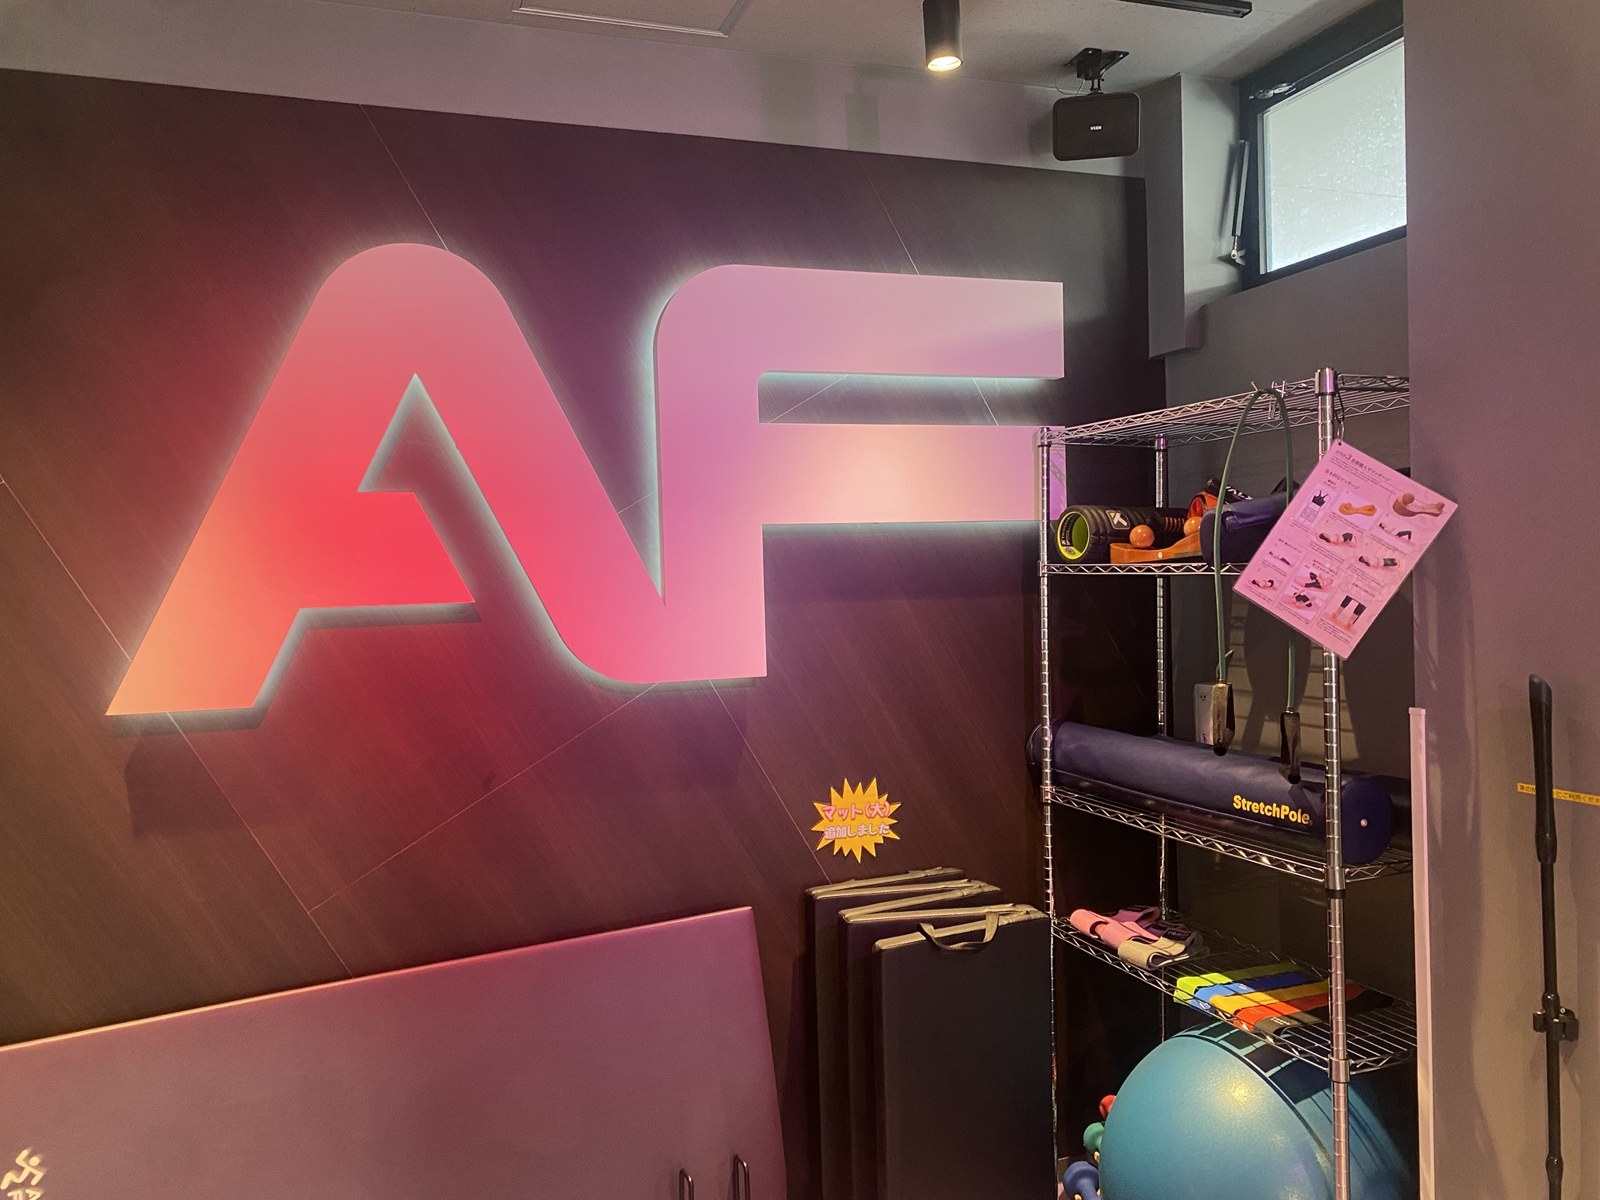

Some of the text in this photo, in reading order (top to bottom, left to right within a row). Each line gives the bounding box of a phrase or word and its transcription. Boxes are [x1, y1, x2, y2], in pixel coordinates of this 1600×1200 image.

[106, 242, 1066, 716] AF
[822, 801, 890, 821] マット(大)
[1233, 794, 1311, 826] StretchPole
[824, 823, 890, 840] 追加しました
